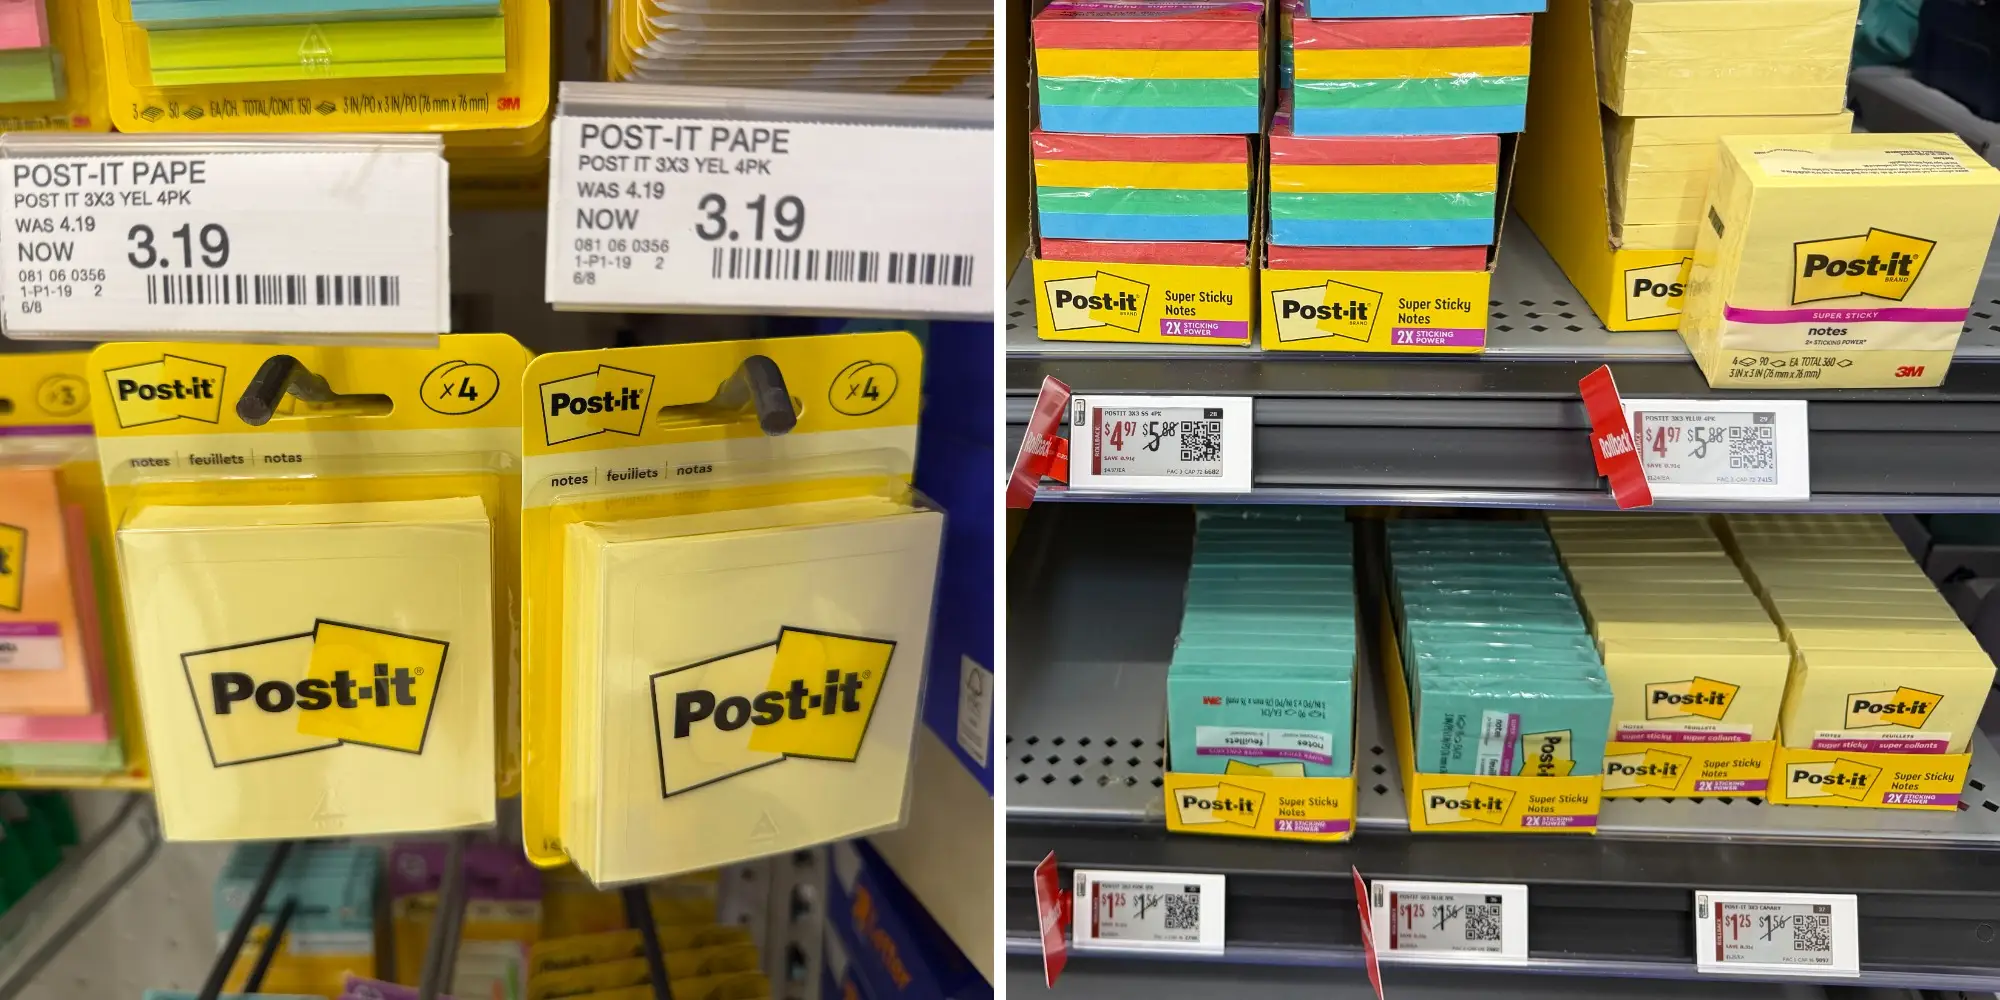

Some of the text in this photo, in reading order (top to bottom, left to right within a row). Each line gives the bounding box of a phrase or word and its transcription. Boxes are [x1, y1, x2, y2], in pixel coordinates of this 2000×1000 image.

[132, 103, 138, 120] 3
[169, 102, 180, 118] 50
[299, 98, 312, 115] 150
[384, 97, 390, 113] 3
[432, 99, 449, 112] mm
[459, 95, 467, 112] 76
[497, 97, 520, 111] 3M
[581, 124, 790, 154] POST-IT PAPE
[579, 155, 771, 175] POST IT 3X3 YEL 4PK
[14, 160, 206, 187] POST-IT PAPE
[577, 182, 664, 199] WAS 4.19
[15, 190, 191, 208] POST IT 3X3 YEL 4PK
[16, 216, 95, 233] WAS 4.19
[576, 209, 638, 230] NOW
[695, 193, 805, 243] 3.19
[18, 242, 74, 262] NOW
[127, 223, 230, 268] 3.19
[575, 239, 669, 253] 081 06 0356
[575, 256, 664, 270] 1-P1-19 2
[1803, 252, 1914, 277] Post-it
[19, 270, 106, 282] 081 06 0356
[573, 272, 595, 285] 6/8
[20, 285, 103, 298] 1-P1-19 2
[1165, 290, 1233, 305] Super Sticky
[1056, 289, 1137, 311] Post-it
[1398, 298, 1471, 313] Super Sticky
[22, 301, 42, 314] 6/8
[1165, 305, 1196, 316] Notes
[1282, 299, 1368, 320] Post-it
[1184, 322, 1219, 330] STICKING
[1398, 313, 1430, 325] Notes
[1167, 321, 1181, 335] 2X
[1808, 327, 1847, 336] notes
[1397, 330, 1413, 344] 2X
[1732, 357, 1835, 366] 4 90 EA TOTAL 360
[1735, 368, 1743, 377] IN
[1755, 368, 1762, 377] IN
[1774, 370, 1788, 378] mm
[1895, 366, 1925, 377] 3M
[118, 377, 213, 402] Post-it
[550, 387, 639, 416] Post-it
[1598, 428, 1633, 460] Rollback
[131, 452, 303, 468] notes feuillets notas
[551, 473, 588, 486] notes
[676, 462, 713, 476] notas
[211, 662, 416, 714] Post-it
[674, 668, 862, 739] Post-it
[1652, 690, 1726, 707] Post-it
[1853, 700, 1929, 717] Post-it
[1225, 737, 1324, 750] notes feuillets
[1646, 733, 1672, 741] sticky
[1842, 741, 1868, 749] sticky
[1879, 742, 1902, 750] super
[1607, 762, 1678, 776] Post-it
[1704, 759, 1762, 771] Super Sticky
[1701, 770, 1728, 778] Notes
[1793, 770, 1868, 786] Post-it
[1894, 772, 1955, 782] Super Sticky
[1699, 782, 1712, 791] 2X
[1891, 782, 1919, 790] Notes
[1183, 796, 1254, 812] Post-it
[1279, 797, 1338, 807] Super Sticky
[1430, 796, 1503, 810] Post-it
[1529, 795, 1588, 804] Super Sticky
[1887, 794, 1903, 803] 2X
[1279, 808, 1305, 816] Notes
[1279, 820, 1293, 831] 2X
[1526, 816, 1540, 826] 2X
